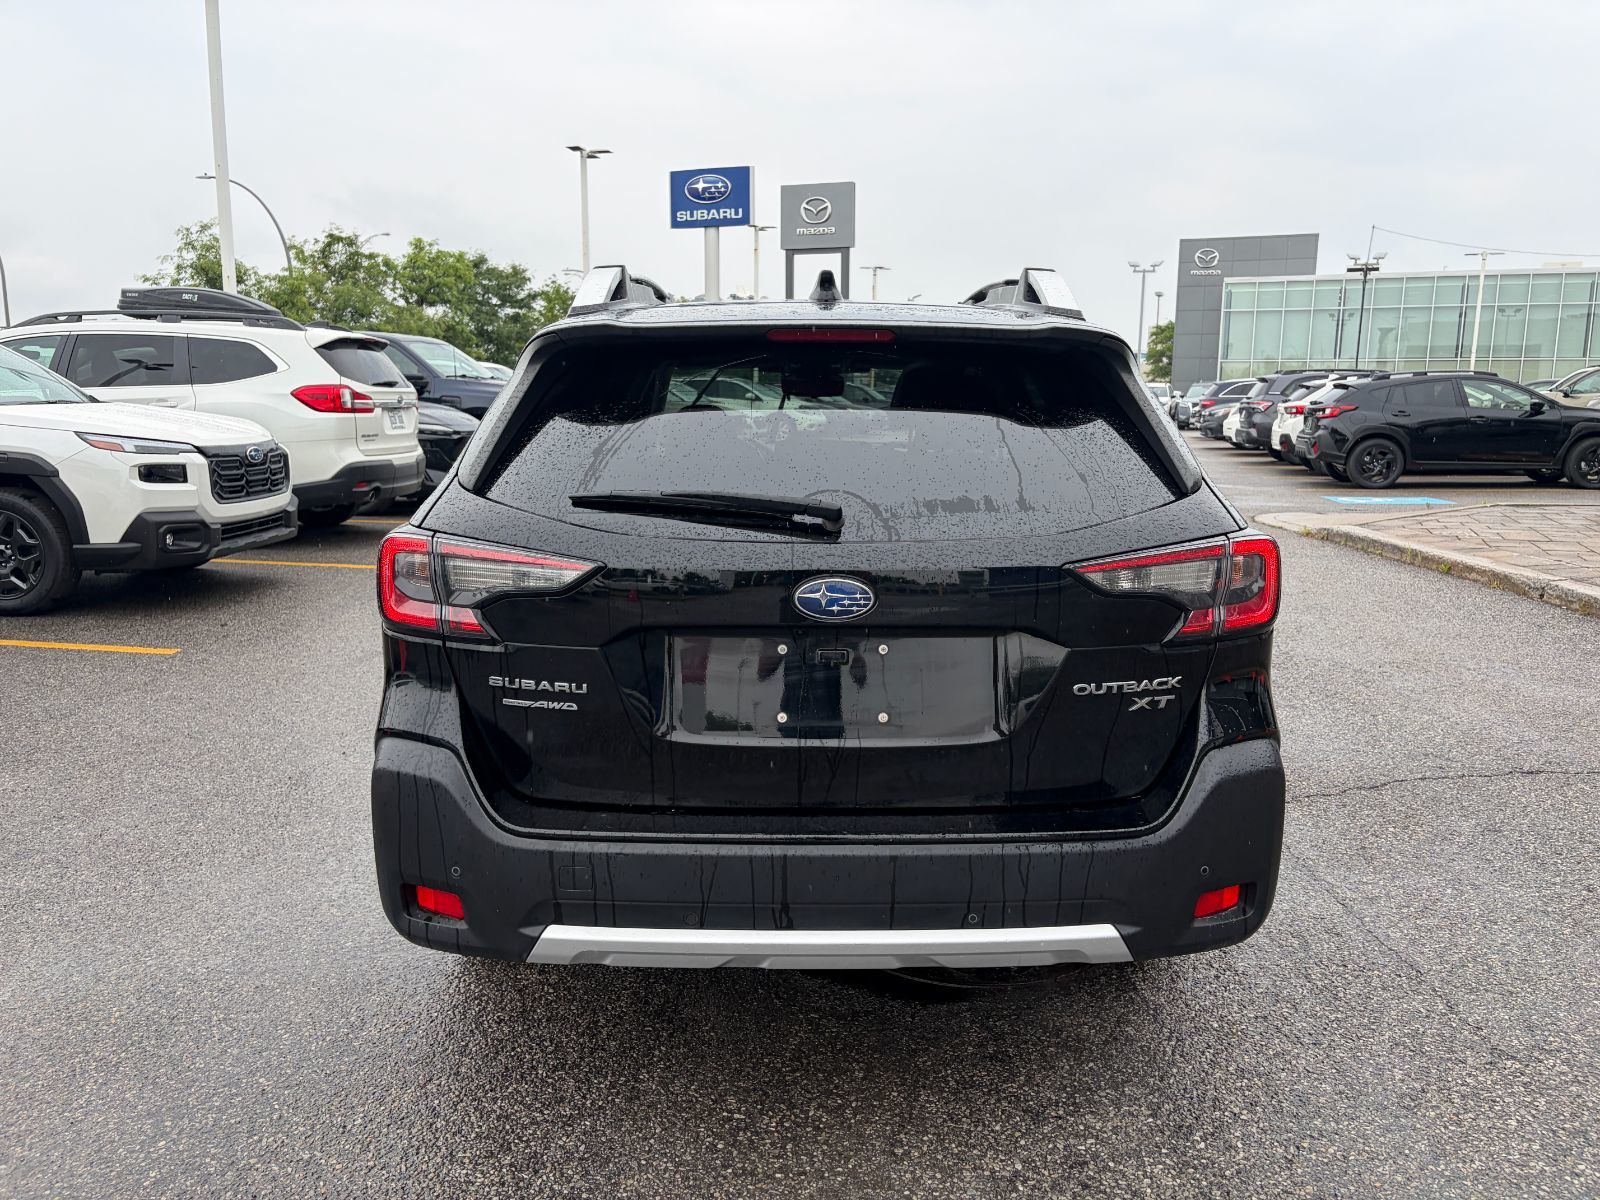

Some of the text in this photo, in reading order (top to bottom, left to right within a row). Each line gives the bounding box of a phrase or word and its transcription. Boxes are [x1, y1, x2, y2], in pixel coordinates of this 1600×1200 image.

[676, 207, 744, 222] SUBARU
[796, 226, 836, 235] mazda
[488, 675, 588, 694] SUBARU
[1072, 676, 1183, 696] OUTBACK
[530, 700, 578, 711] AWD
[1128, 694, 1176, 712] XT
